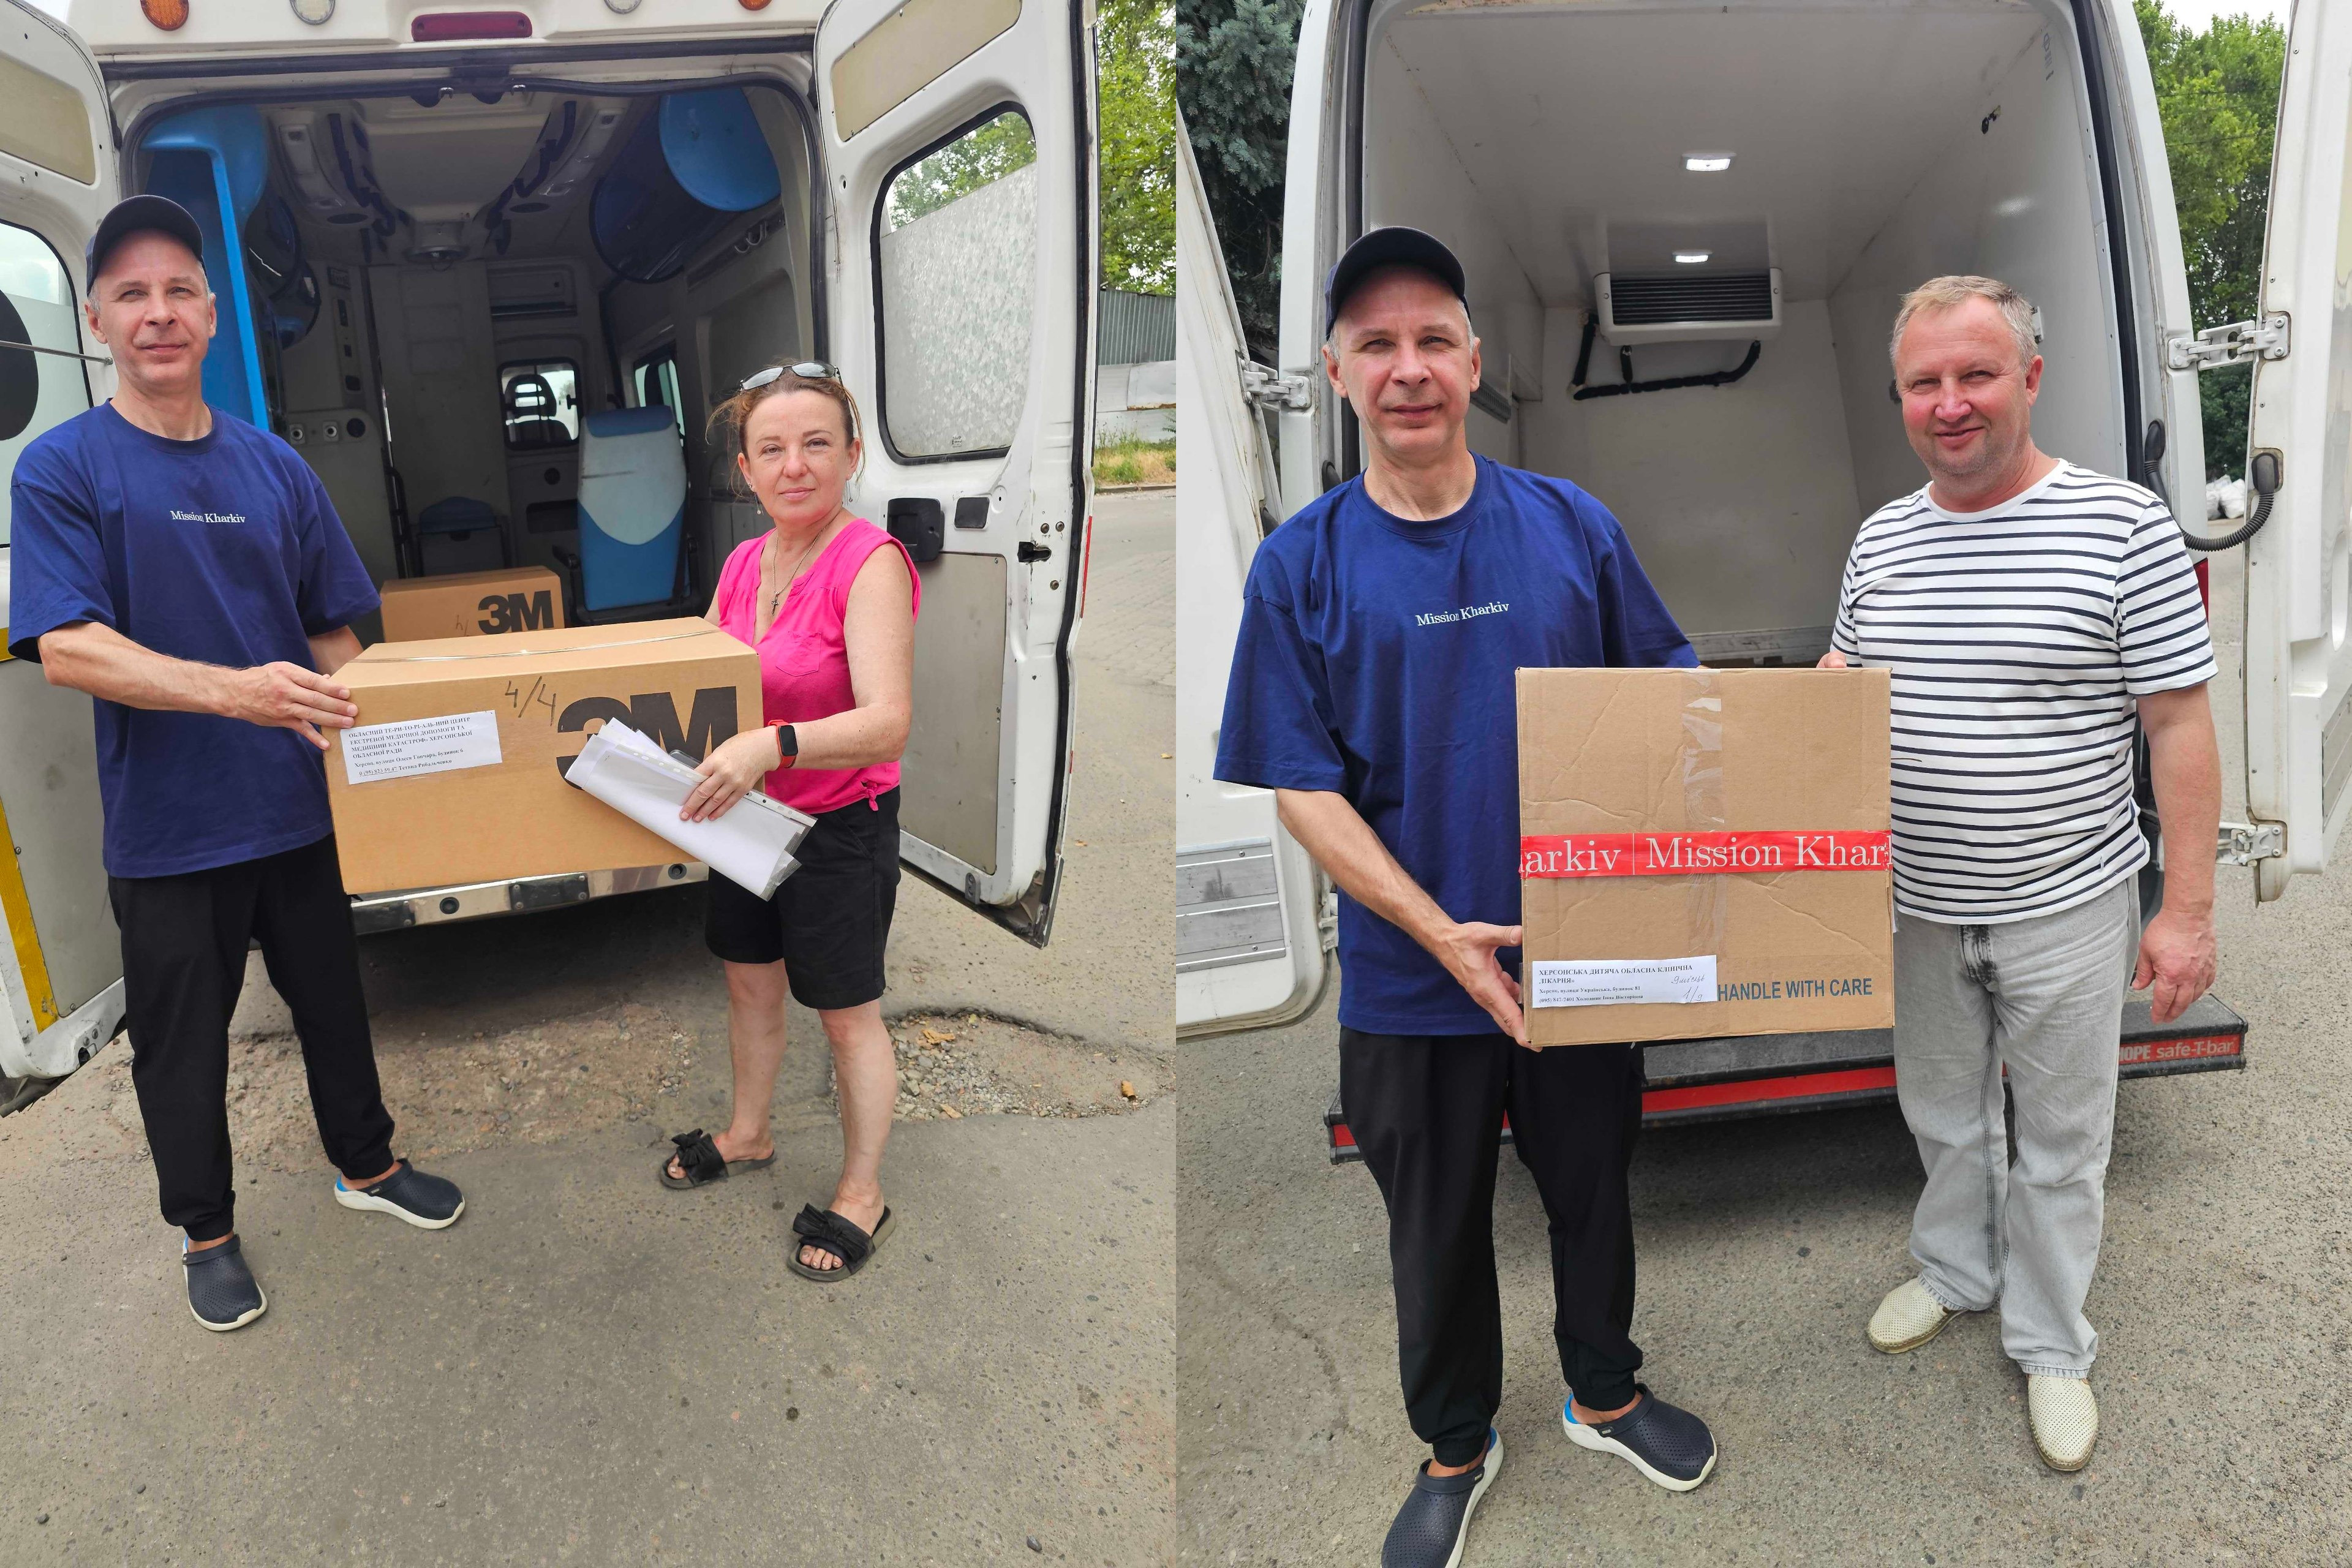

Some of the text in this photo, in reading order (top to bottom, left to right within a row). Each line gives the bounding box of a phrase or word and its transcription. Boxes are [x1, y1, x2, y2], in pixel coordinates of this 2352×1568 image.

[170, 510, 246, 523] Mission Kharkiv
[478, 590, 554, 635] 3M
[1415, 601, 1510, 627] Mission Kharkiv
[504, 676, 557, 727] 4/4
[349, 728, 383, 738] ОБЛАСНИЙ
[353, 749, 385, 759] ОБЛАСНОЇ
[1519, 840, 1622, 873] arkiv
[1645, 837, 1784, 869] Mission
[1717, 978, 1873, 1001] HANDLE WITH CARE
[2156, 1040, 2234, 1059] safe-T-bar
